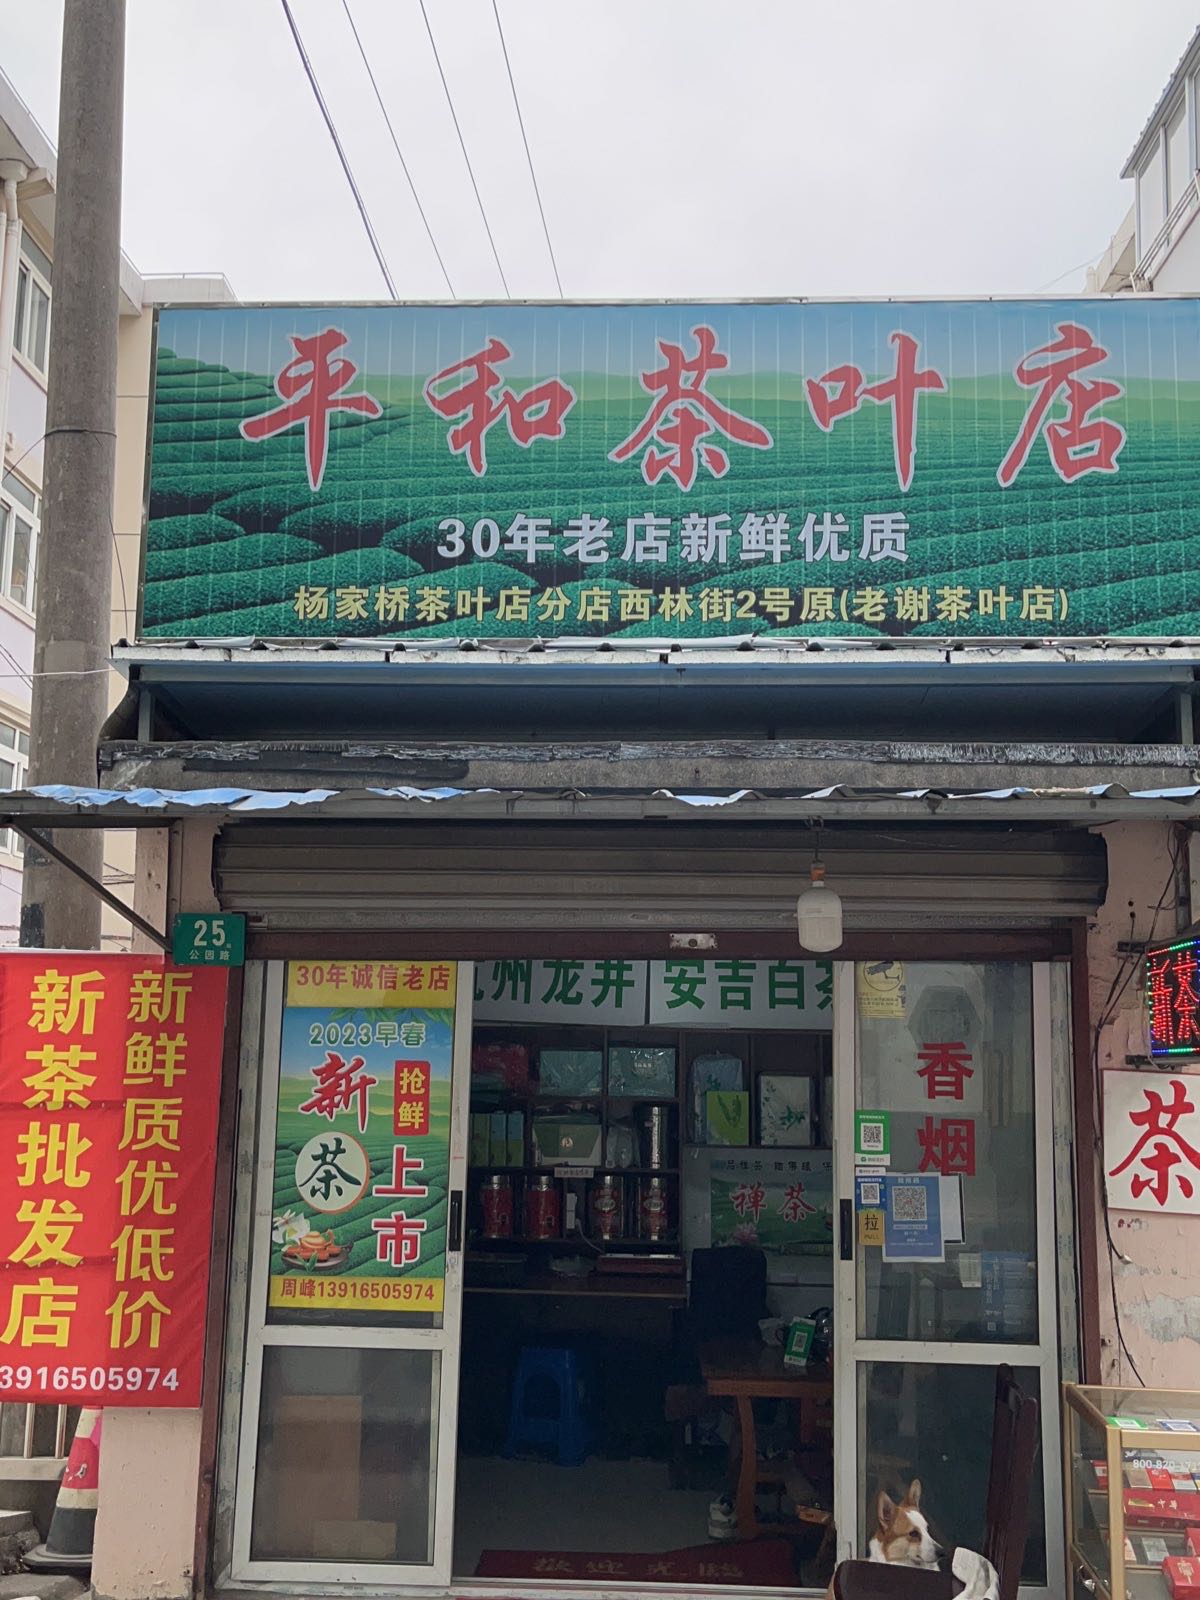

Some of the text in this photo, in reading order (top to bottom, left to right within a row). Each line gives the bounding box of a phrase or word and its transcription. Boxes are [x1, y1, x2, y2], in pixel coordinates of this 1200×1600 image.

[240, 325, 1126, 491] 平和茶叶店
[437, 512, 910, 564] 30年老店新鲜优质
[294, 586, 1069, 623] 杨家桥茶叶店分店西林街2号原(老谢茶叶店)
[189, 948, 231, 961] 公园路
[193, 919, 226, 947] 25
[297, 963, 450, 991] 30年诚信老店
[474, 960, 635, 1009] 州龙井
[309, 1023, 426, 1047] 2023早春
[398, 1068, 426, 1130] 抢鲜
[917, 1041, 976, 1177] 香烟
[0, 970, 106, 1348] 新茶批发店
[105, 970, 193, 1349] 新鲜质优低价
[1108, 1079, 1200, 1206] 茶
[372, 1145, 429, 1267] 上市
[864, 1213, 879, 1231] 拉
[280, 1278, 434, 1301] 周峰13916505974
[0, 1366, 179, 1391] 3916505974
